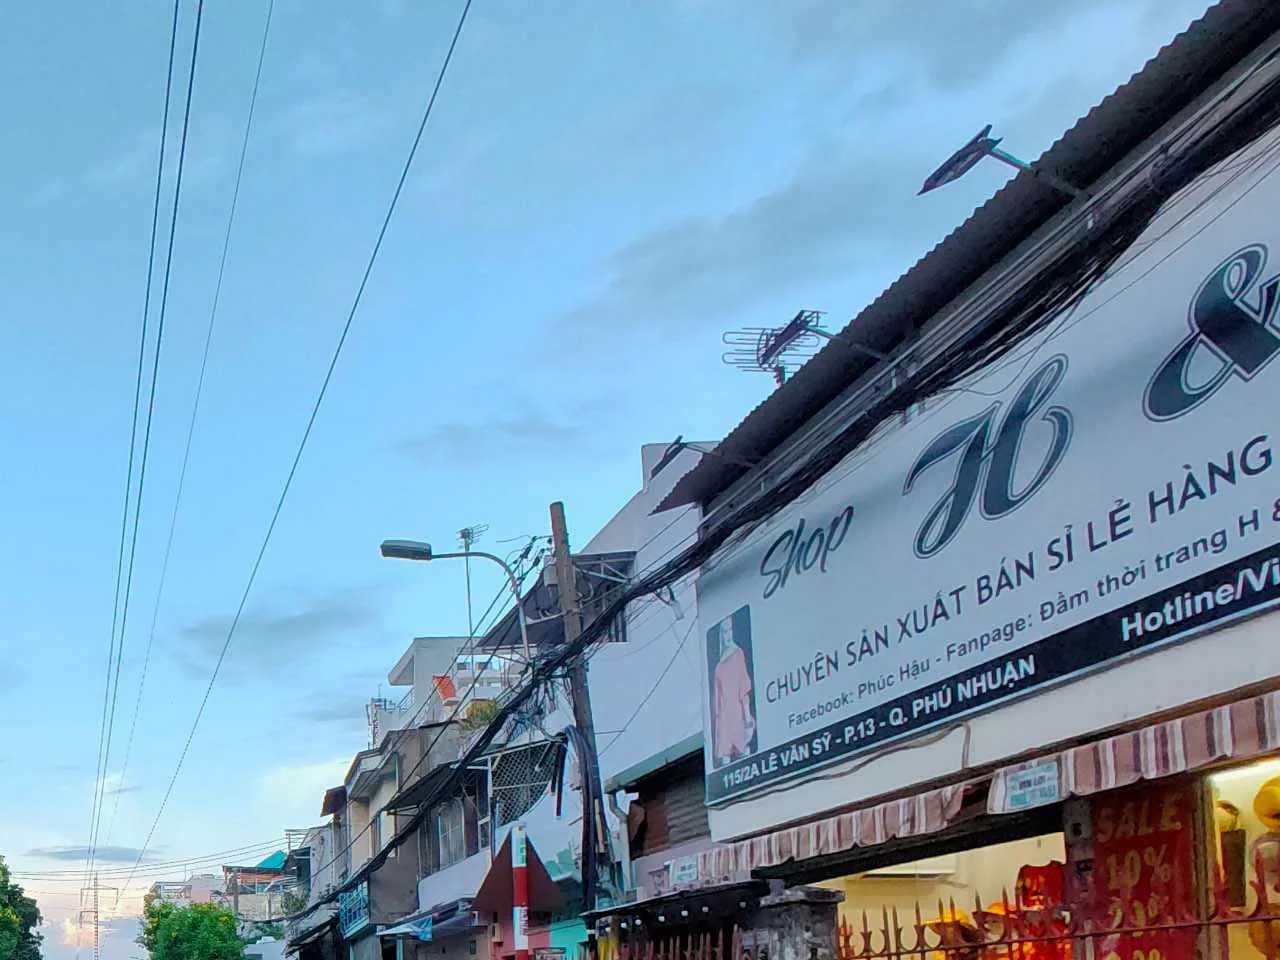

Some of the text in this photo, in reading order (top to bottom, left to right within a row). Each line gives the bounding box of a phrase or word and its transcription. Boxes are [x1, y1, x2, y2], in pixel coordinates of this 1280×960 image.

[760, 505, 854, 599] Shop
[766, 434, 1273, 704] CHUYÊN SẢN XUẤT BÁN SỈ LẺ HÀNG
[788, 691, 853, 728] Facebook:
[857, 672, 895, 700] Phúc
[899, 655, 931, 682] Hậu
[946, 614, 1033, 662] Fanpage:
[1039, 590, 1089, 622] Đầm
[1097, 560, 1147, 597] thời
[1155, 529, 1228, 573] trang
[1238, 508, 1260, 537] H
[723, 763, 760, 789] 115/2A
[761, 753, 779, 775] LÊ
[780, 743, 811, 767] VĂN
[812, 732, 832, 755] SỸ
[844, 717, 877, 744] P.13
[889, 707, 909, 726] Q.
[912, 683, 952, 719] PHÚ
